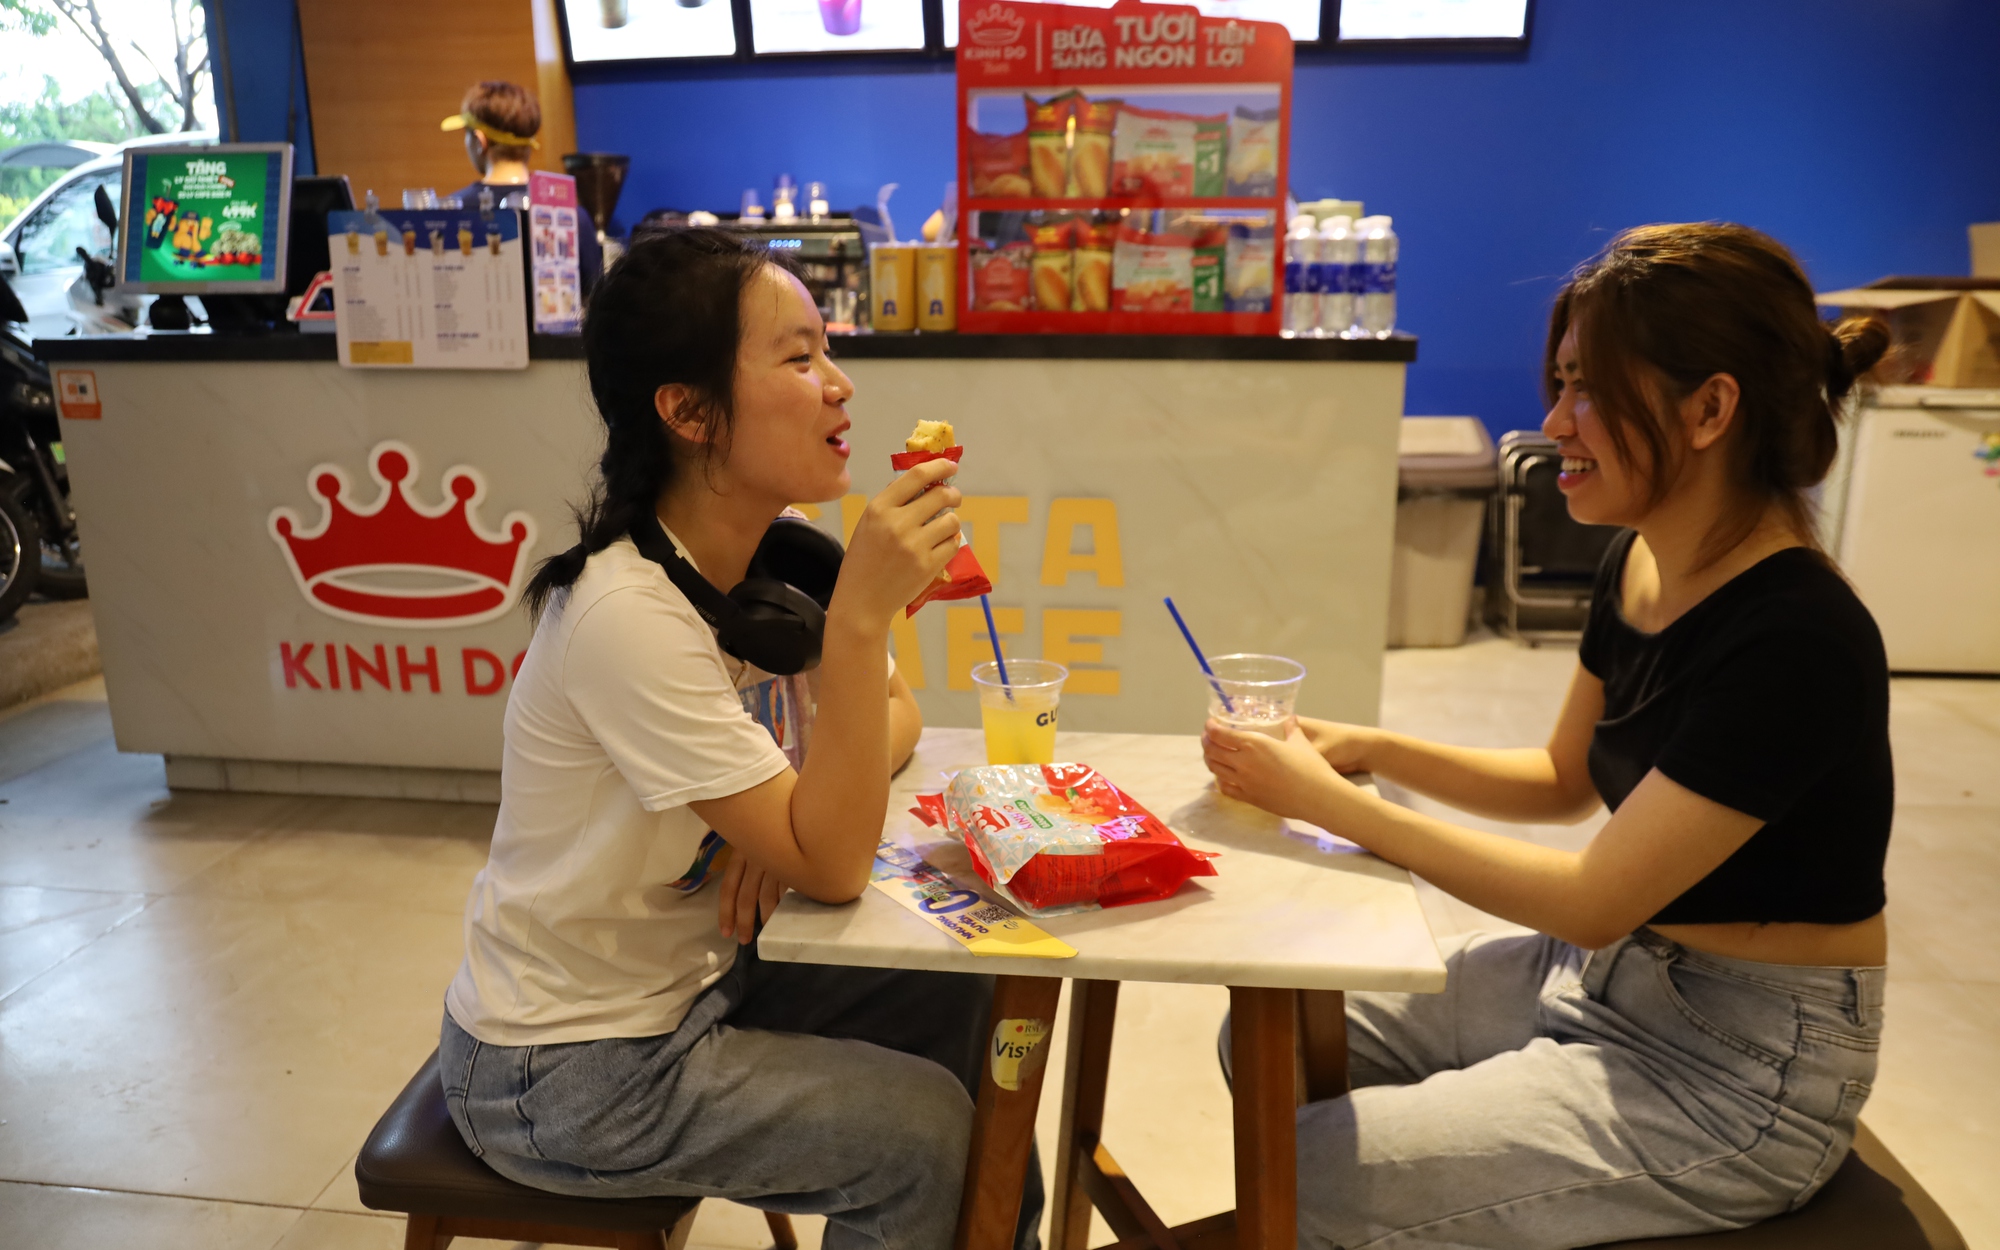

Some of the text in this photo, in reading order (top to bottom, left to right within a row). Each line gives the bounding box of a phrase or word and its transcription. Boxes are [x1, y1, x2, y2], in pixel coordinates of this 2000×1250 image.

[1052, 25, 1106, 49] BỮA
[1114, 11, 1197, 44] TƯƠI
[1114, 45, 1197, 69] NGON
[279, 641, 442, 694] KINH
[995, 1036, 1037, 1058] Visi
